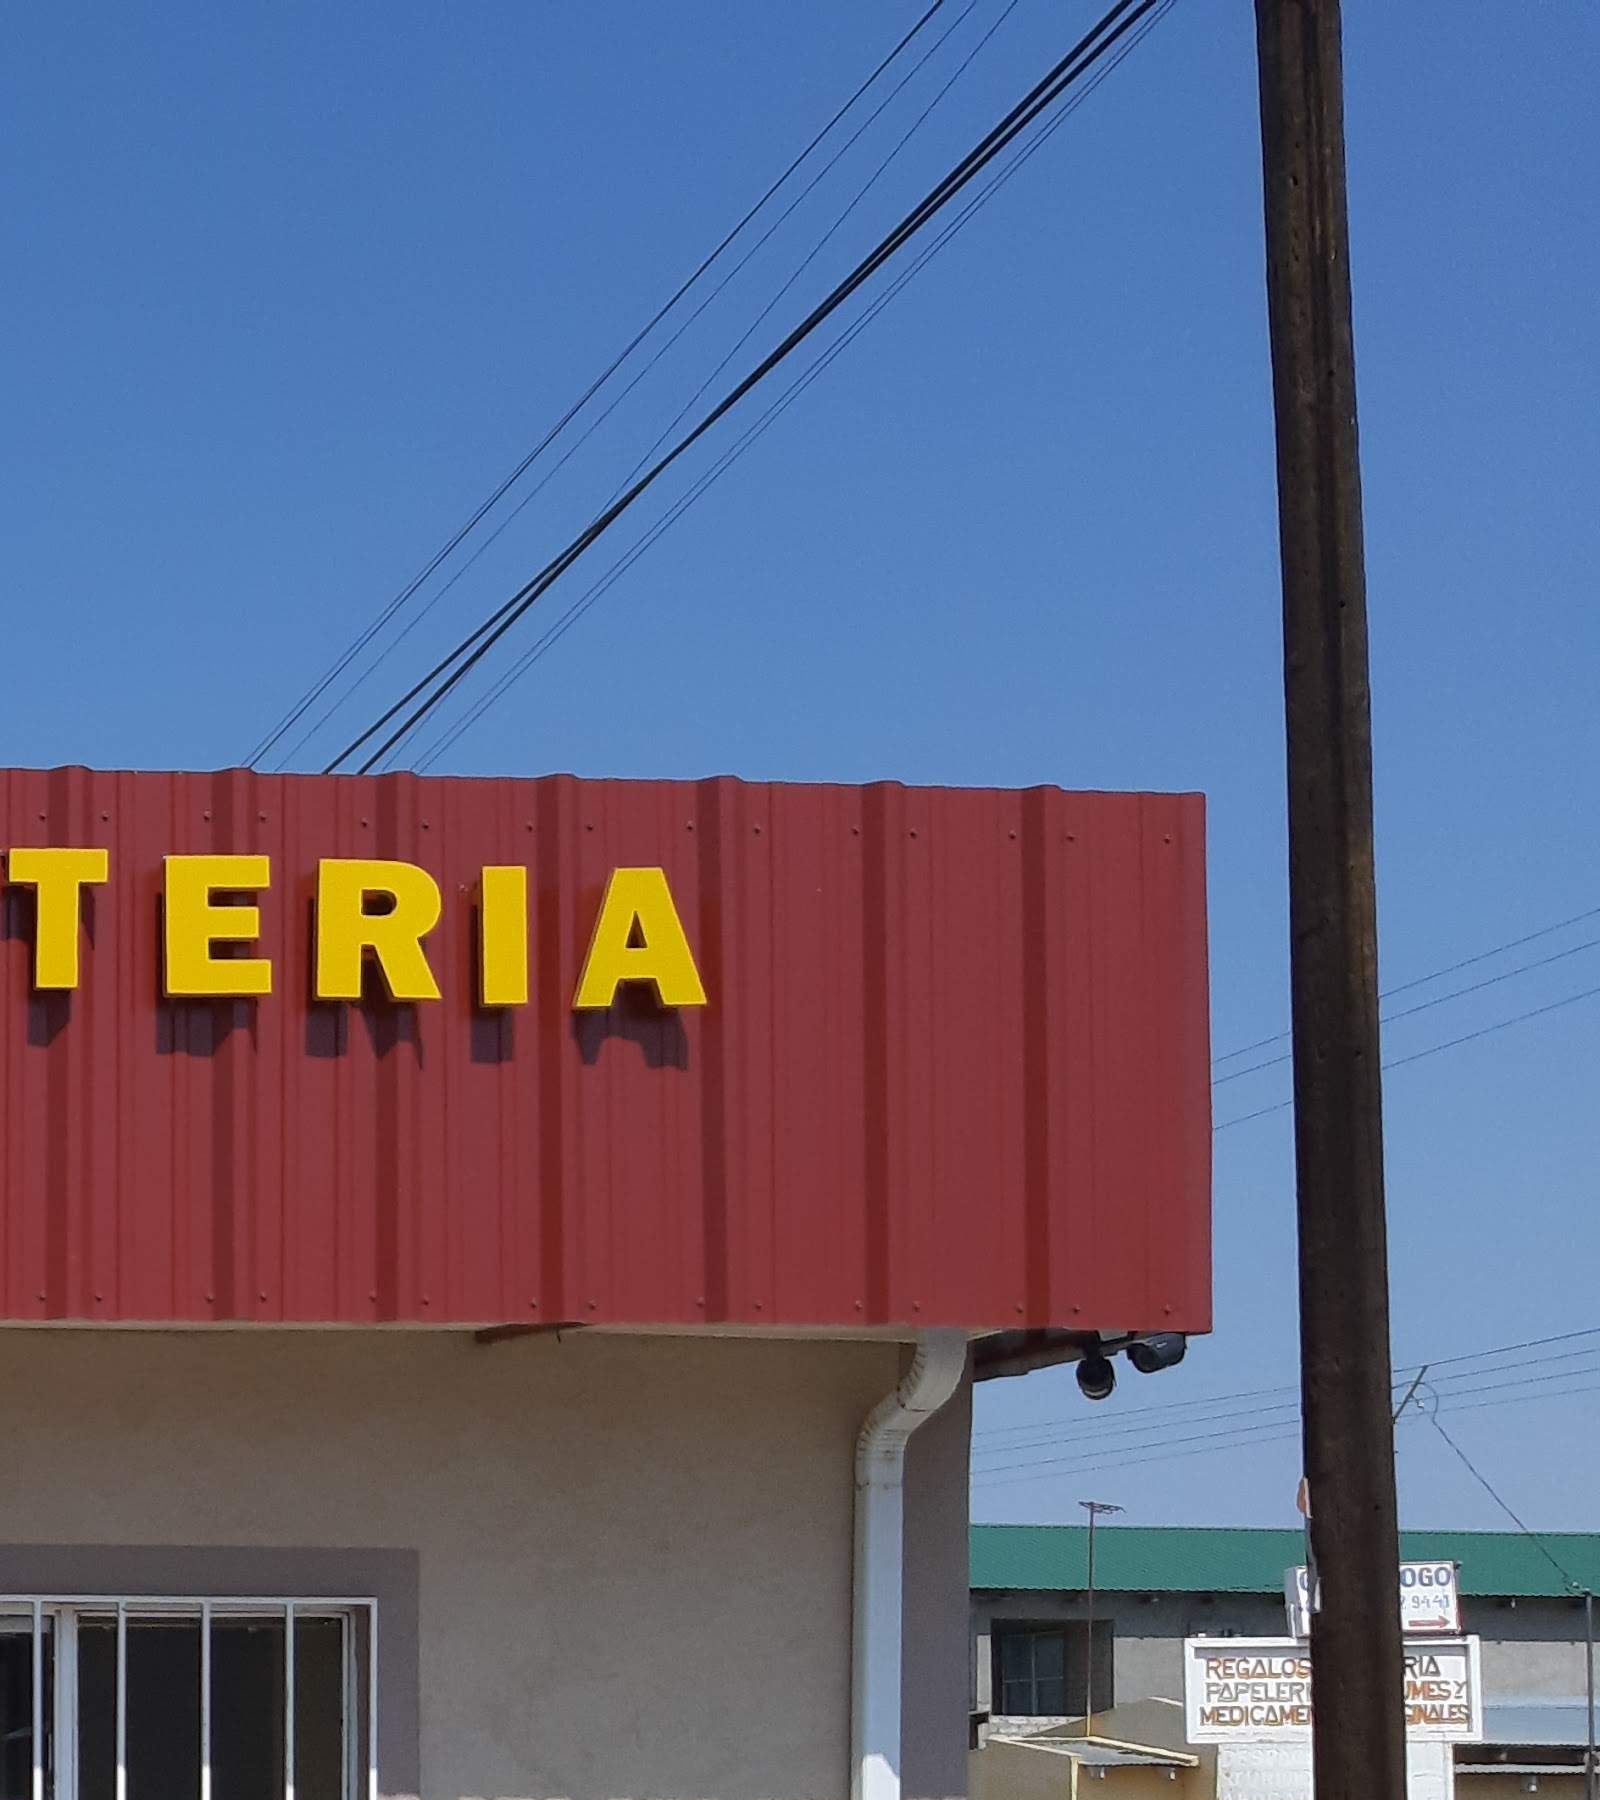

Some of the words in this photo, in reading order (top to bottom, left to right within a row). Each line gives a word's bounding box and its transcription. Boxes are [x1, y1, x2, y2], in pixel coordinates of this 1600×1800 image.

[1400, 1567, 1451, 1588] OGO
[1205, 1656, 1312, 1682] REGALOS
[1206, 1681, 1311, 1704] PAPELERI
[1199, 1704, 1312, 1727] MEDICAME
